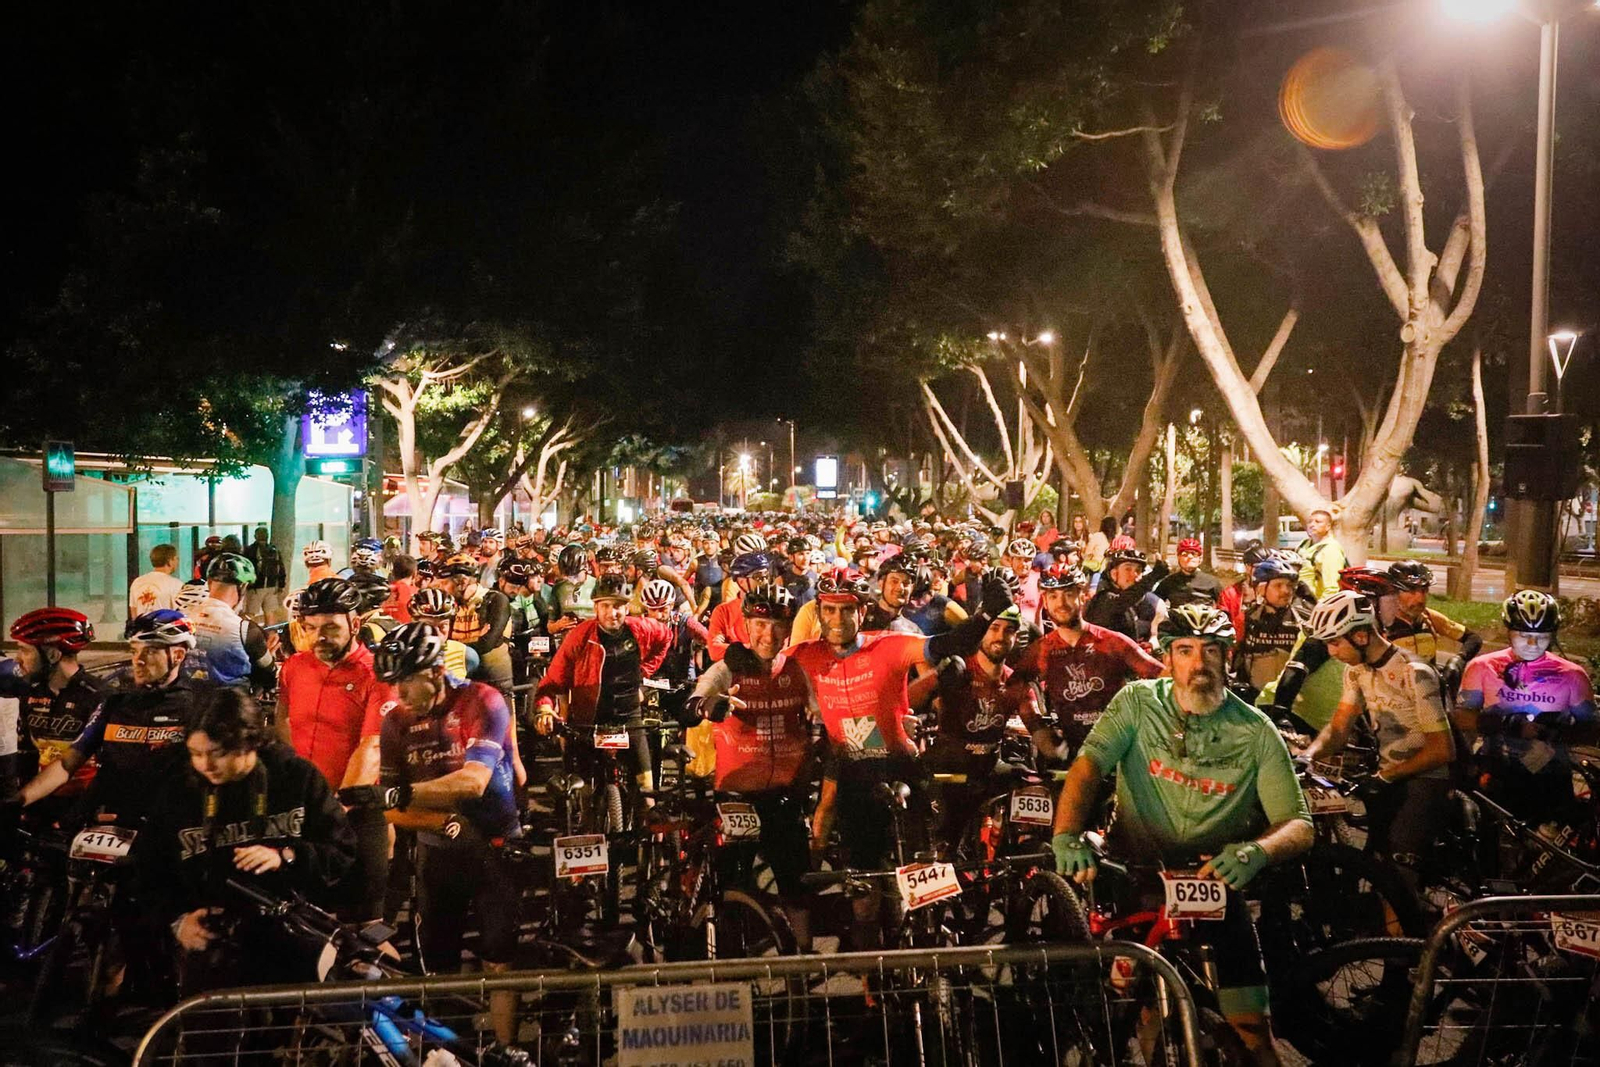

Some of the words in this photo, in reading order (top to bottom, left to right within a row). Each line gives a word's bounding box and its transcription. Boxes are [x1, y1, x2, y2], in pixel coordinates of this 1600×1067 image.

[116, 726, 141, 739] Bull
[1018, 797, 1050, 813] 5638
[728, 814, 757, 828] 5259
[84, 833, 127, 849] 4117
[564, 845, 601, 860] 6351
[907, 866, 948, 889] 5447
[1175, 882, 1221, 903] 6296
[633, 991, 708, 1016] ALYSER
[715, 989, 741, 1011] DE
[622, 1021, 751, 1050] MAQUINARIA
